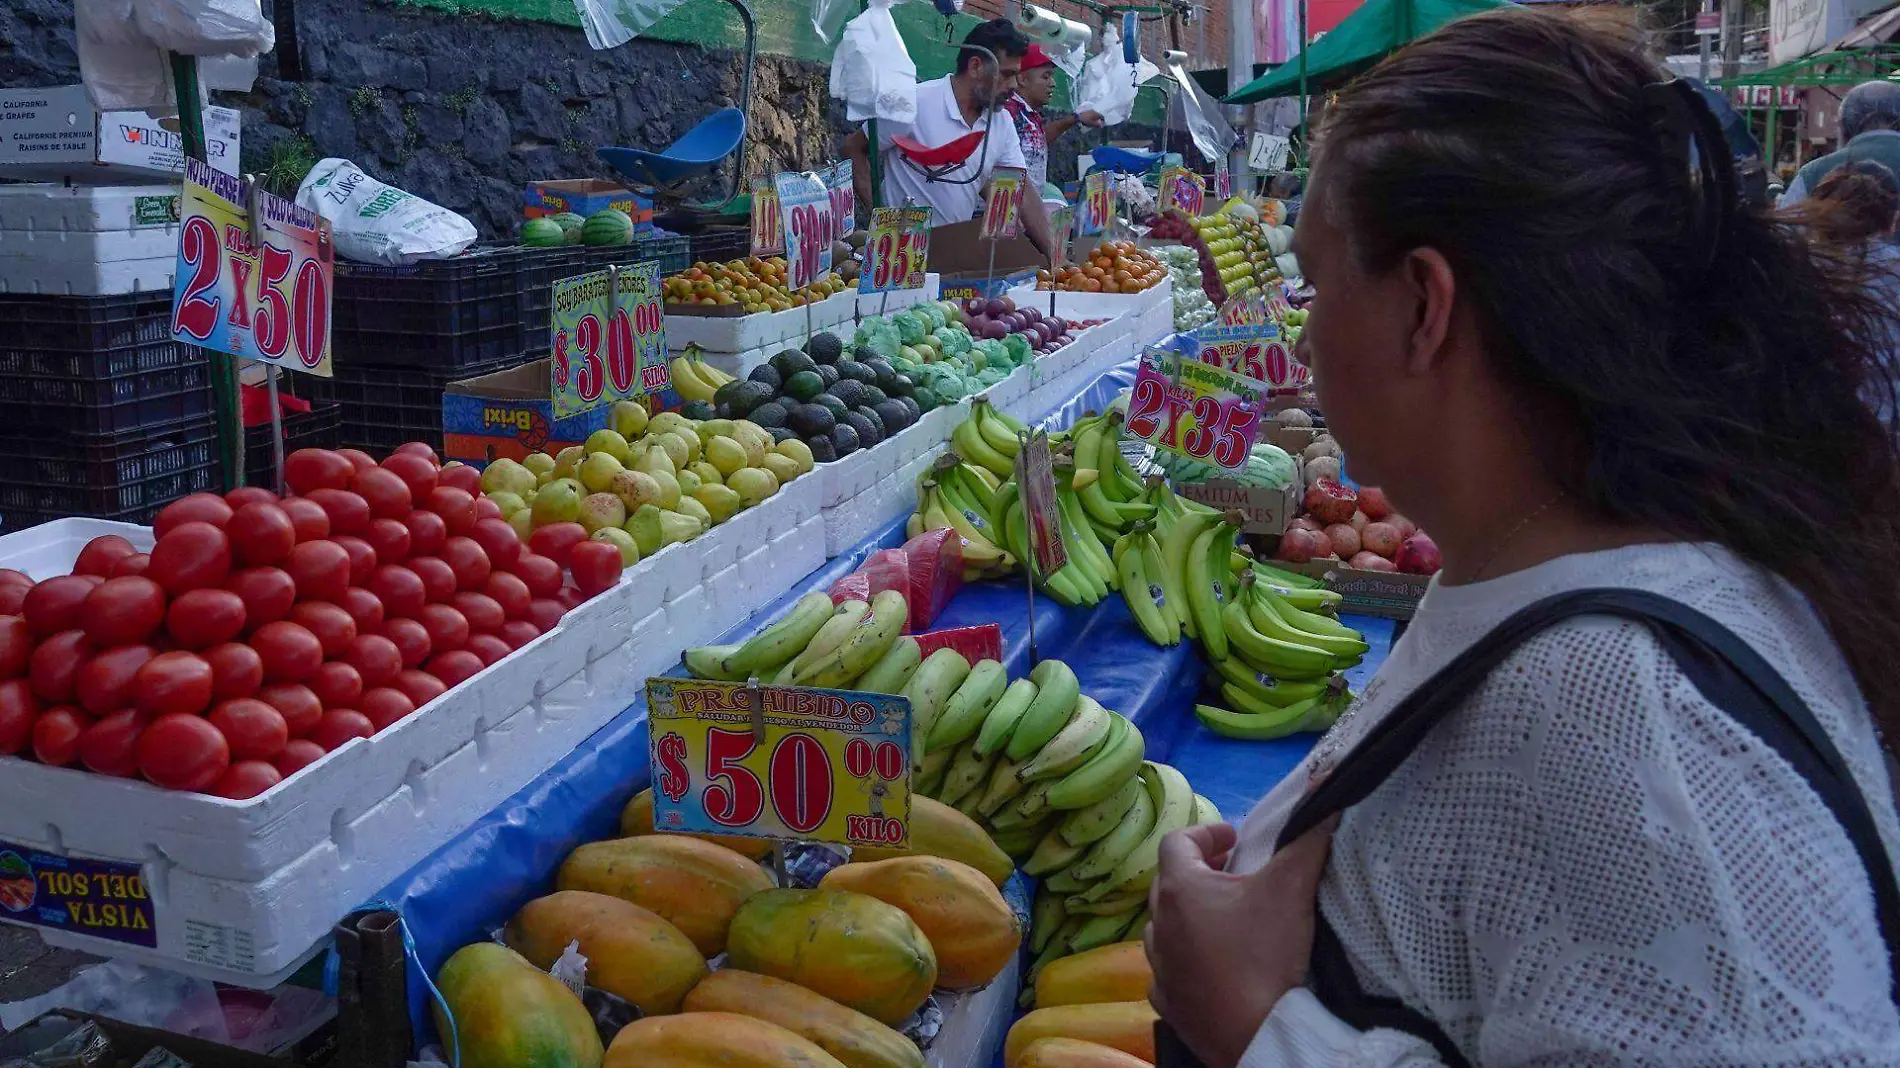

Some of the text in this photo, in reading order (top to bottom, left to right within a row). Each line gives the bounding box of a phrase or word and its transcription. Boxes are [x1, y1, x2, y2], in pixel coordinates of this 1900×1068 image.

[3, 101, 48, 109] CALIFORNIA
[6, 112, 36, 120] GRAPES
[19, 143, 48, 152] RAISINS
[48, 143, 60, 151] DE
[58, 131, 93, 139] PREMIUM
[324, 172, 364, 206] Zulka
[172, 215, 222, 341] 2
[253, 241, 328, 368] 50
[634, 302, 661, 336] 00
[642, 363, 669, 390] KILO
[483, 407, 531, 431] Brixi
[1126, 379, 1166, 440] 2
[1184, 395, 1256, 469] 35
[844, 737, 904, 781] 00
[847, 814, 904, 844] KILO
[39, 870, 147, 900] DEL SOL
[67, 901, 150, 930] VISTA
